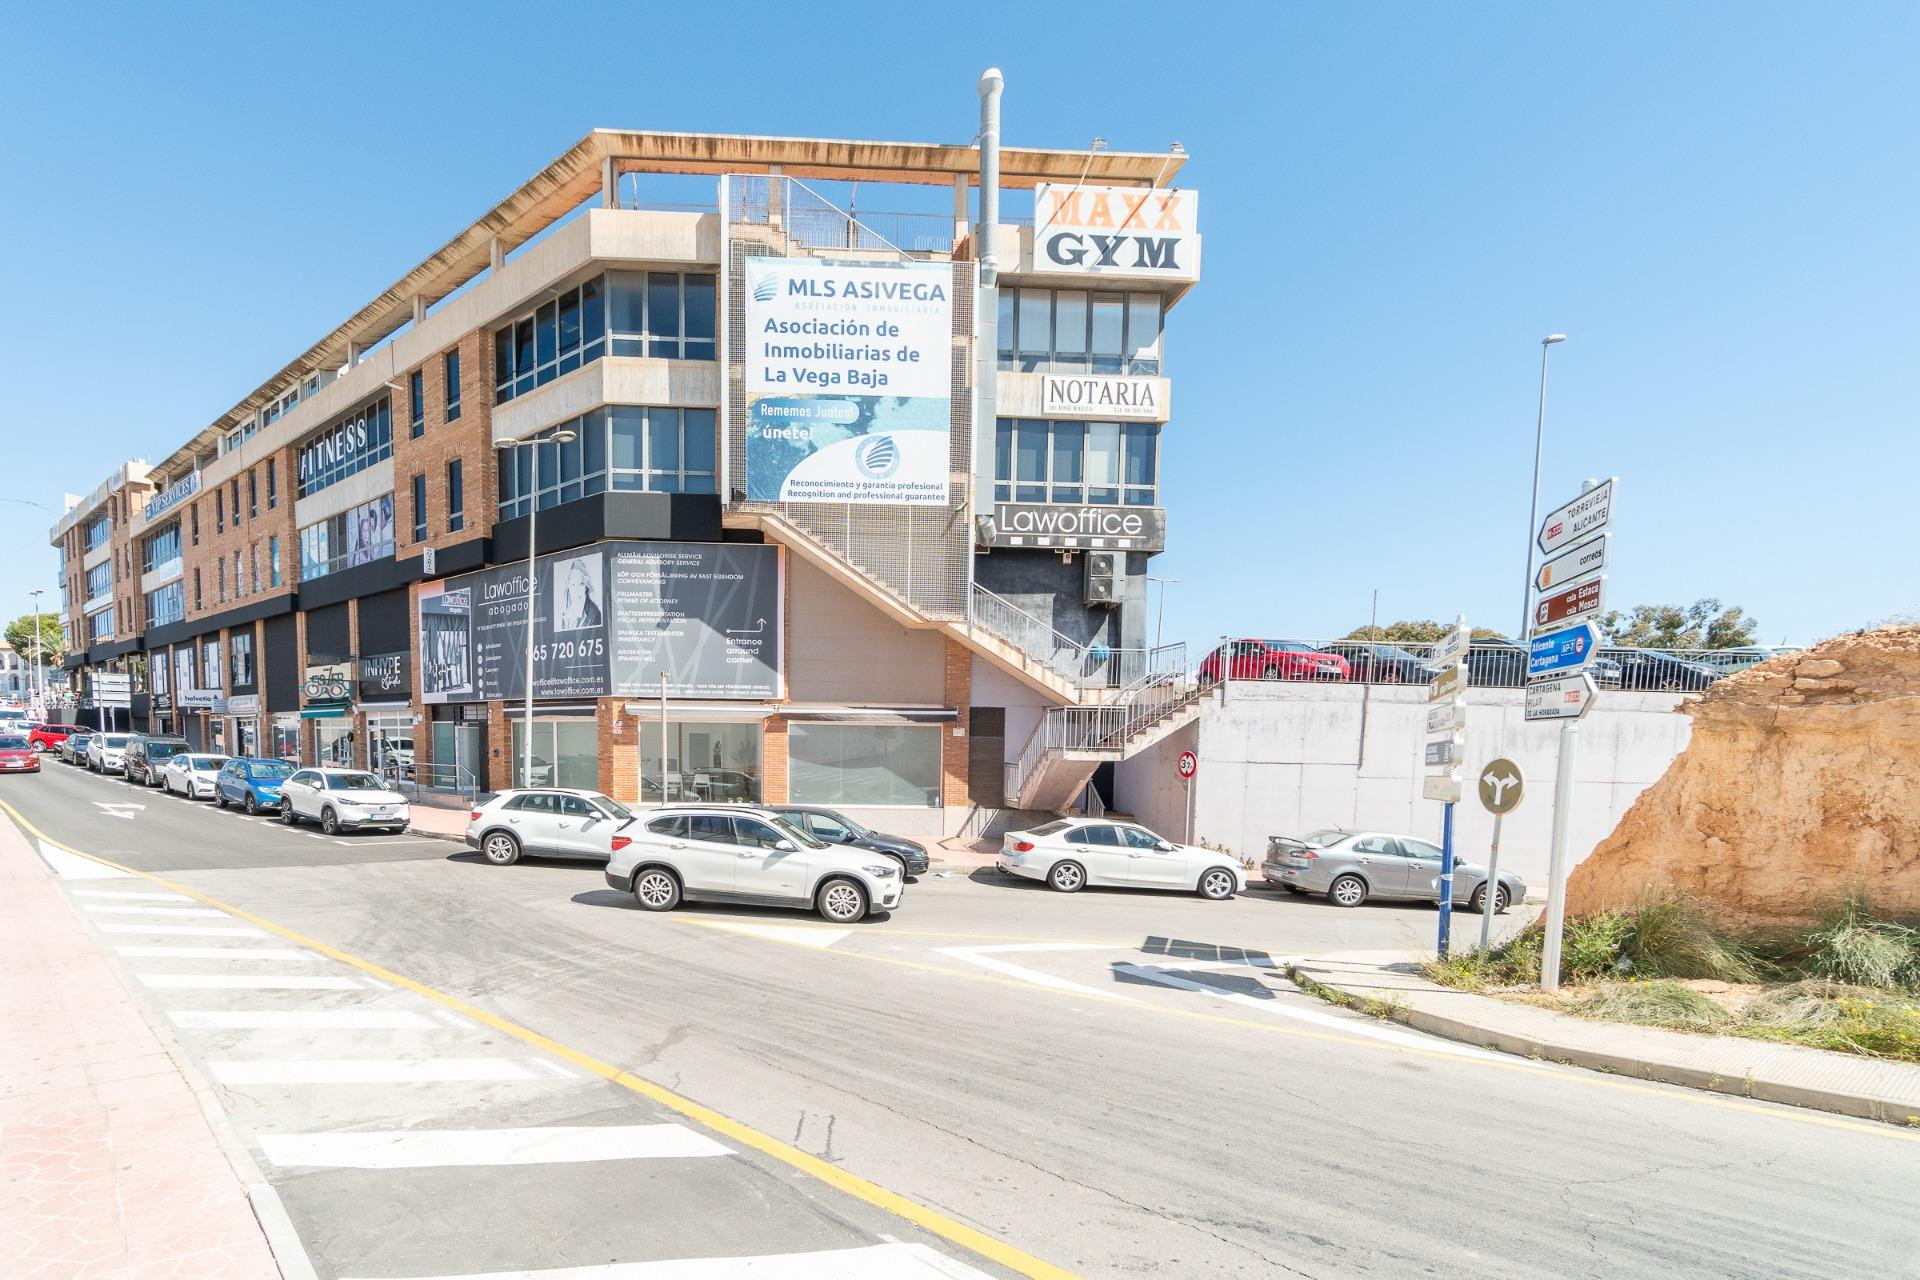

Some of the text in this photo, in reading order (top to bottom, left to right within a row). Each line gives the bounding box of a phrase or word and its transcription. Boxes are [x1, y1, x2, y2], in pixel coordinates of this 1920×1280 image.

[1048, 190, 1183, 230] MAXX
[1046, 232, 1181, 270] GYM
[788, 279, 945, 302] MLS ASIVEGA
[764, 318, 899, 337] Asociación de
[764, 342, 920, 362] Inmobiliarias de
[764, 366, 888, 388] La Vega Baja
[1050, 380, 1154, 406] NOTARIA
[761, 404, 811, 417] Rememos
[762, 425, 814, 440] únete!
[788, 490, 835, 499] Recognition
[854, 492, 902, 500] professional
[790, 480, 854, 488] Reconocimiento
[898, 483, 943, 492] profesional
[1568, 490, 1608, 519] TORREVIEJA
[1002, 506, 1142, 534] Lawoffice
[1572, 507, 1606, 532] ALICANTE
[1580, 549, 1602, 566] correos
[1578, 584, 1599, 598] Estaca
[488, 601, 529, 615] abogado
[1578, 598, 1598, 612] Mosca
[552, 642, 574, 660] 720
[578, 638, 604, 657] 675
[1532, 639, 1574, 653] Alicante AP-7
[366, 656, 400, 676] INHYPE
[1530, 654, 1558, 668] Cartagena
[1529, 682, 1560, 696] CARTAGENA
[1528, 698, 1542, 708] PILAR
